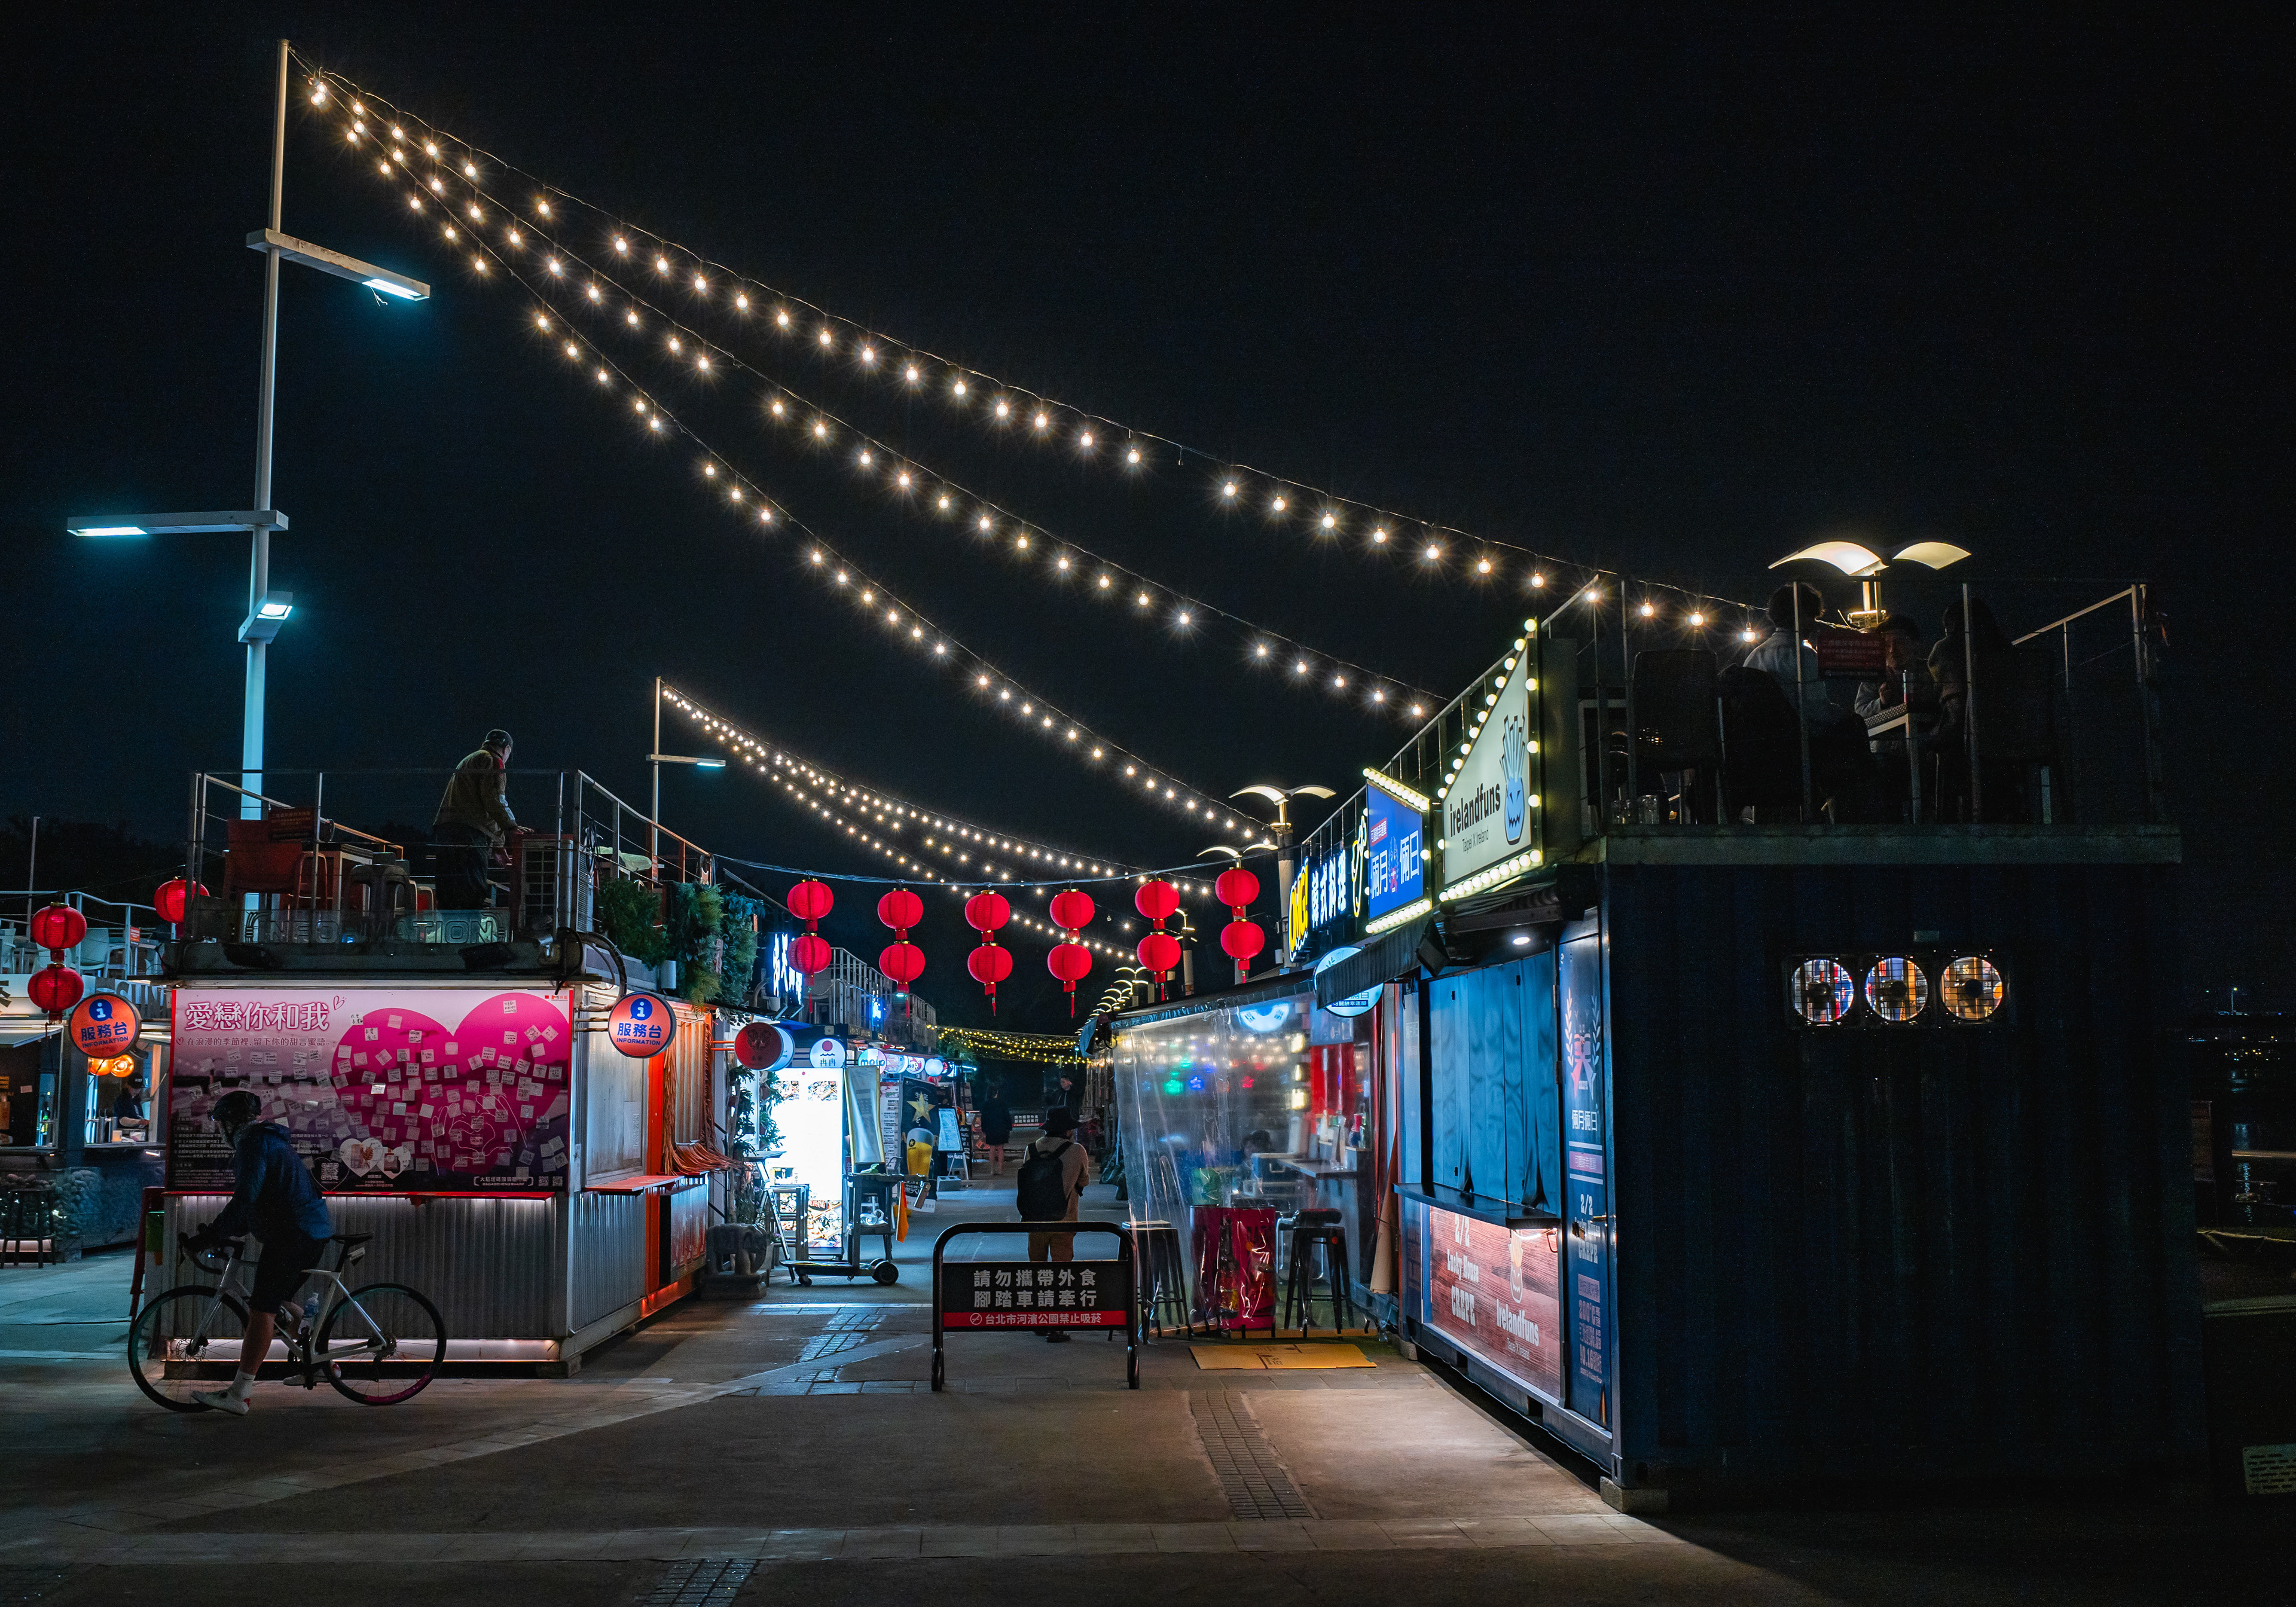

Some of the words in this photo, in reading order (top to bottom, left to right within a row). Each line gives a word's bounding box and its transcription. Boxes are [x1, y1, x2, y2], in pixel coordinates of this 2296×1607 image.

[1450, 783, 1500, 837] irelandfuns
[1476, 826, 1489, 845] Ireland
[1289, 863, 1308, 952] OMG!
[185, 1002, 329, 1031] 愛戀你和我
[81, 1022, 127, 1041] 服務台
[617, 1023, 662, 1038] 服務台
[83, 1036, 129, 1048] INFORMATION
[1580, 1194, 1593, 1215] 2/2
[1455, 1213, 1470, 1247] 2/2
[1578, 1241, 1598, 1264] CREPE
[1447, 1248, 1463, 1281] Lucky
[1463, 1255, 1479, 1283] House
[974, 1269, 1097, 1287] 請勿攜帶外食
[974, 1290, 1097, 1308] 腳踏車請牽行
[1451, 1285, 1476, 1327] CREPE
[985, 1313, 1101, 1325] 台北市河濱公園禁止吸菸
